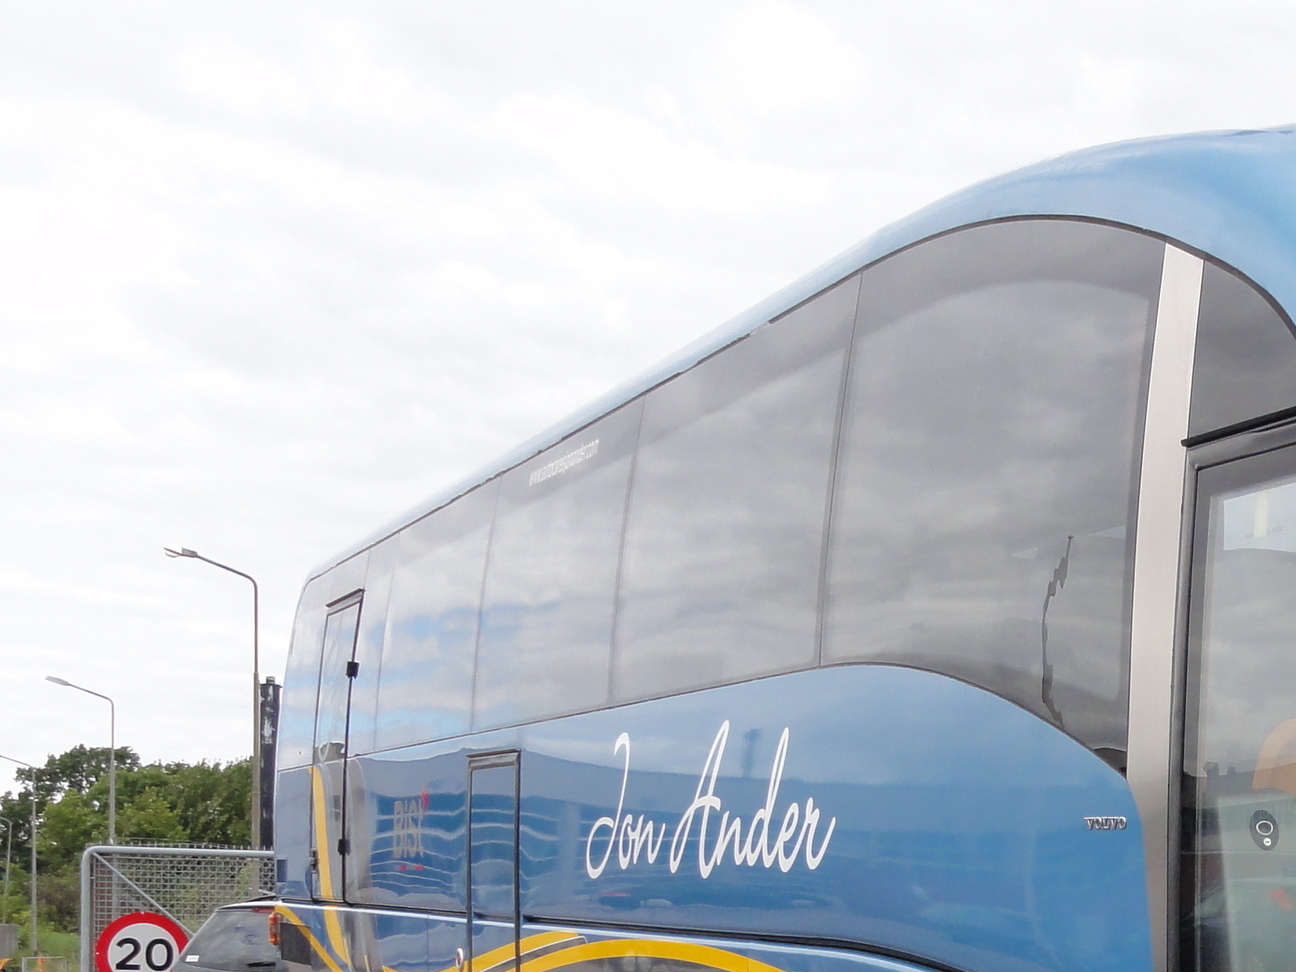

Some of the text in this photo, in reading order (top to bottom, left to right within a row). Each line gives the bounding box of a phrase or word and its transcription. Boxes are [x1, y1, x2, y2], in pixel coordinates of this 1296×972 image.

[586, 719, 836, 879] Jon Ander
[115, 937, 174, 972] 20
